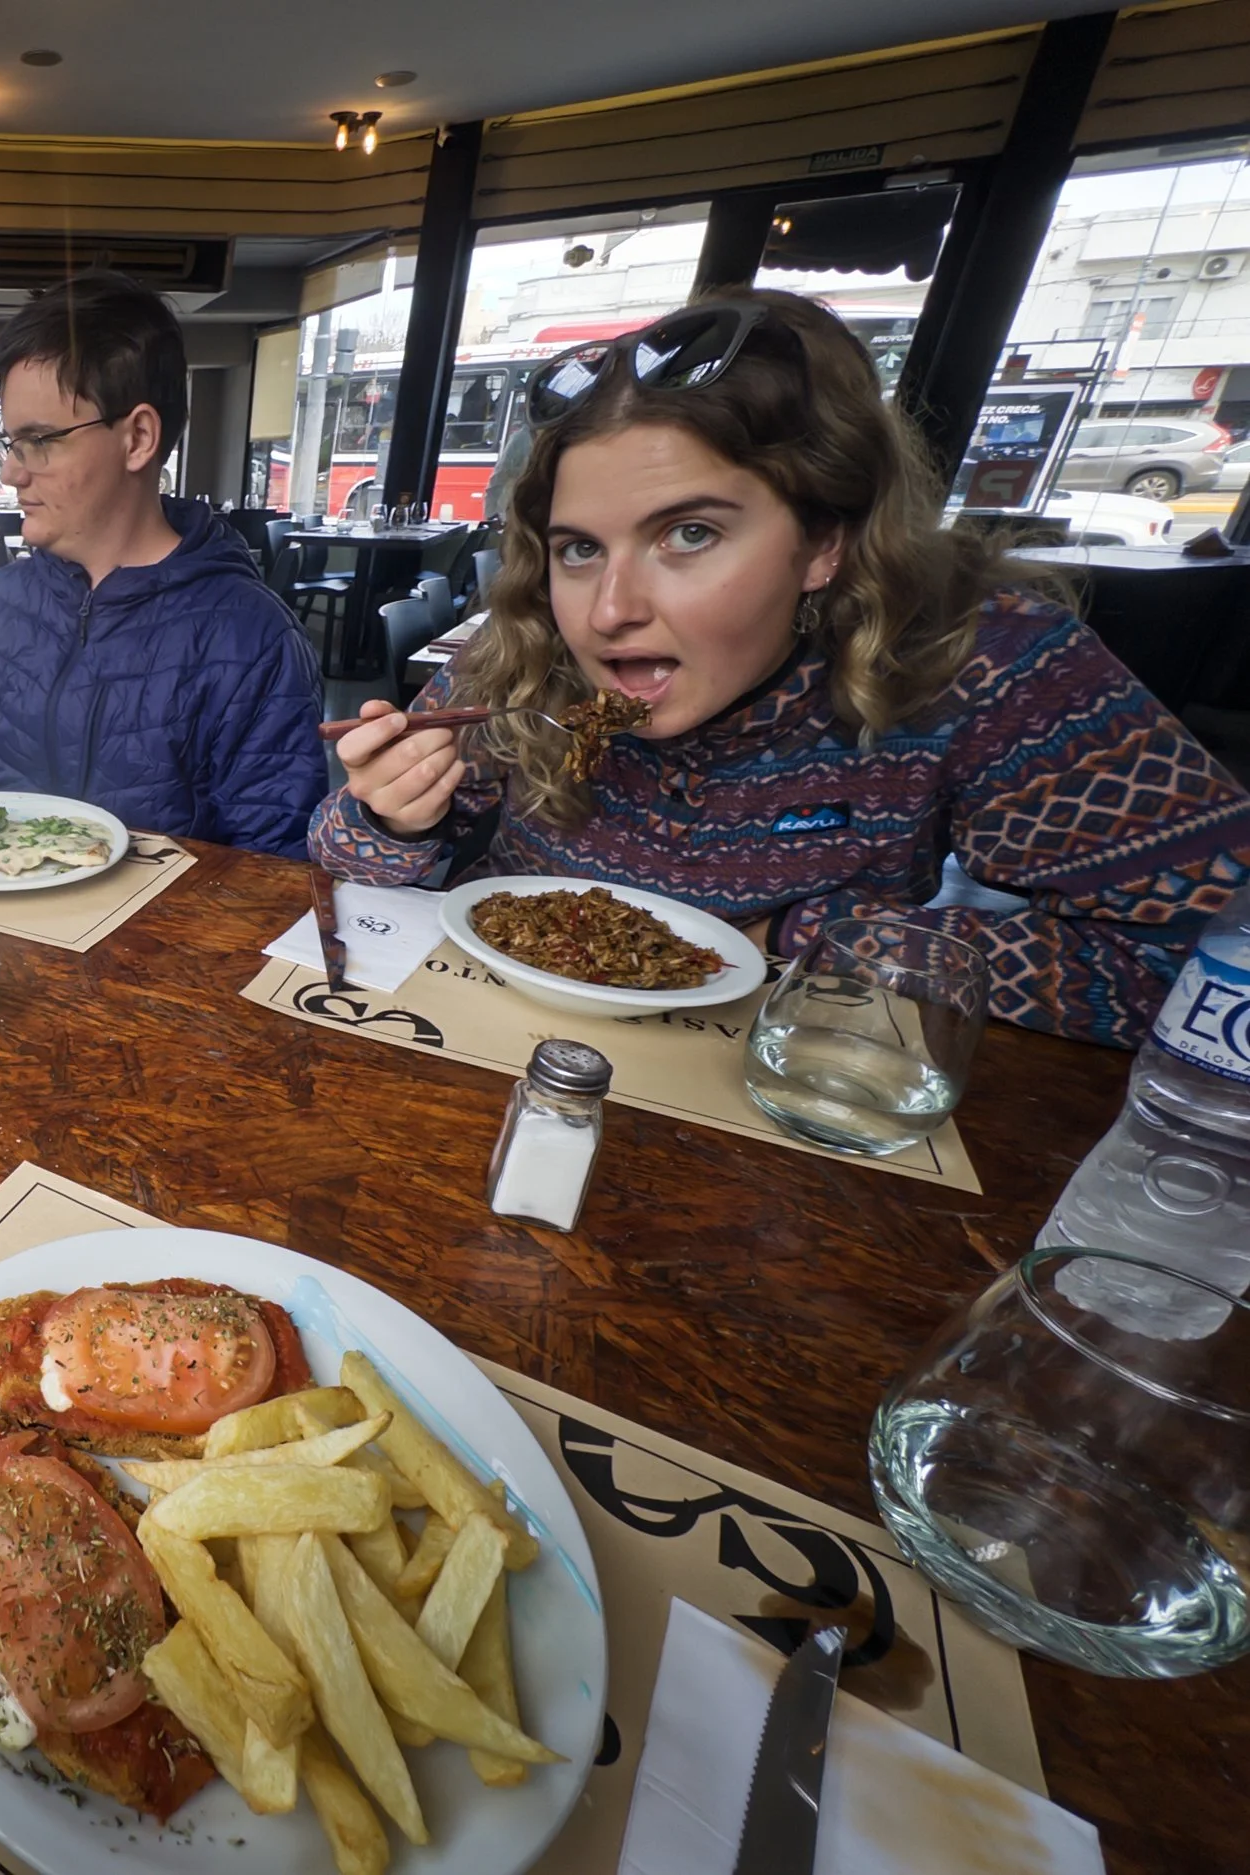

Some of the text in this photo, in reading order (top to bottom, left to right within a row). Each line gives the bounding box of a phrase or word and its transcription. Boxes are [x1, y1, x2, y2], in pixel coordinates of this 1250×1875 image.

[813, 147, 879, 162] SALIDA
[996, 405, 1042, 414] CRECE.
[778, 818, 836, 831] KAVU
[1179, 1040, 1235, 1068] DE LOS
